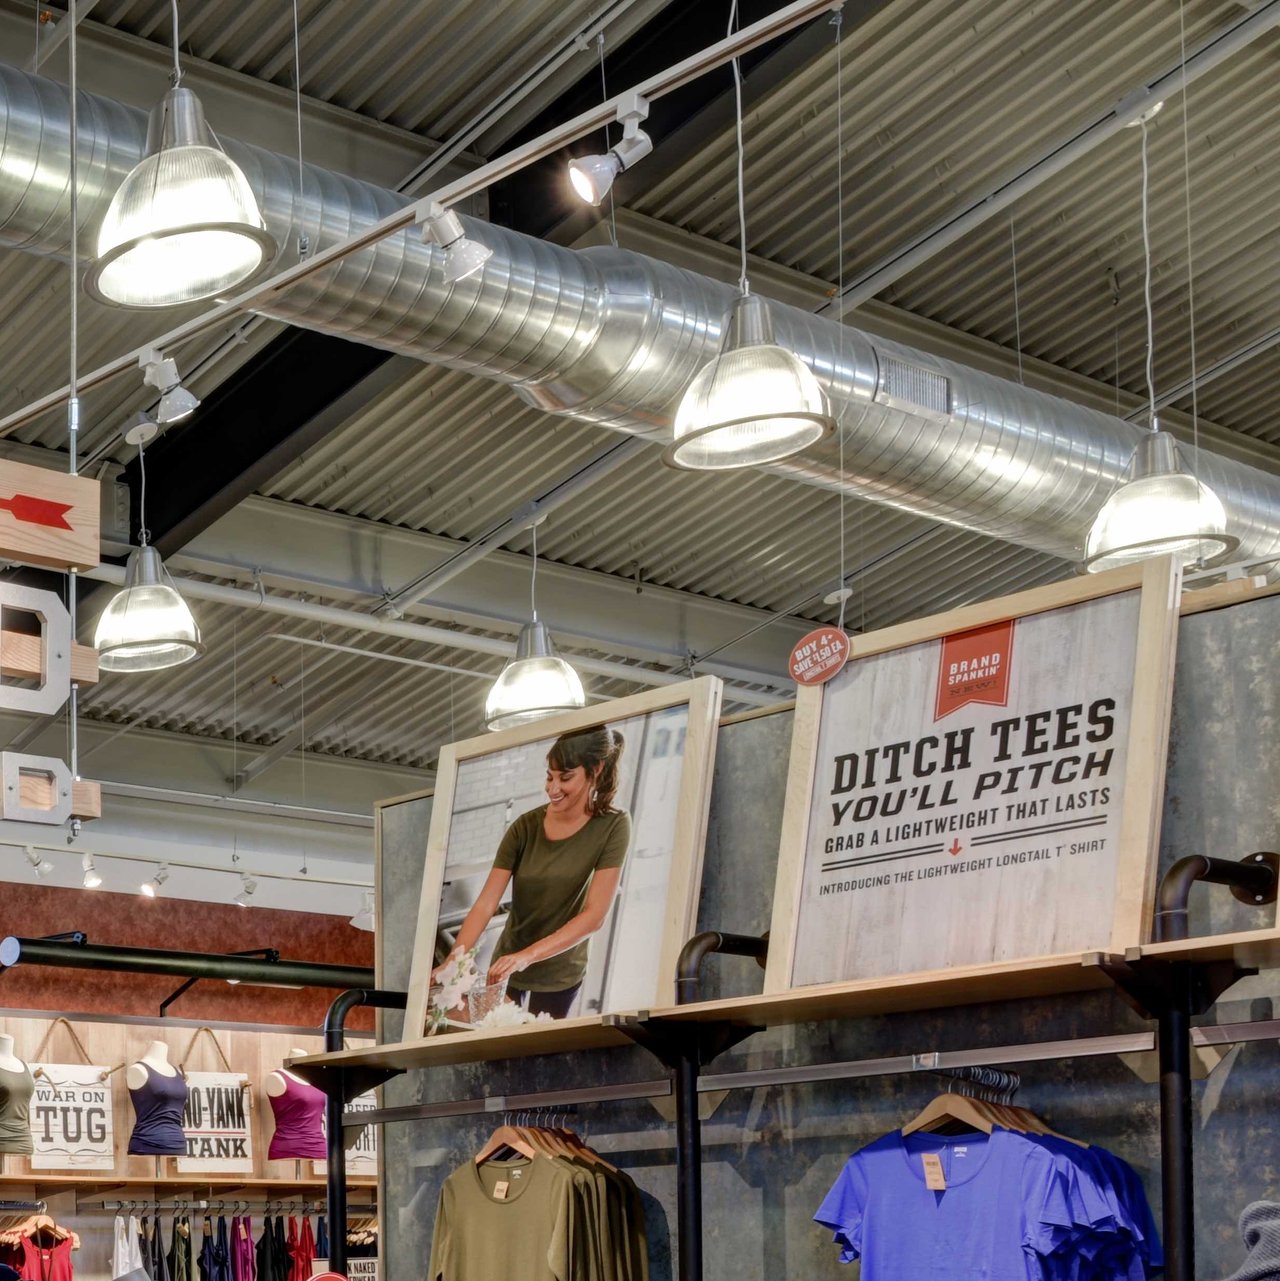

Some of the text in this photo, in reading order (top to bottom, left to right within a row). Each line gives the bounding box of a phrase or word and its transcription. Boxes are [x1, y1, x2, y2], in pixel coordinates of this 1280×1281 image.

[795, 640, 817, 661] BUY
[793, 656, 814, 676] SAVE
[950, 653, 1001, 675] BRAND
[948, 665, 1001, 685] SPANKIN'
[830, 698, 1116, 796] DITCH TEES
[831, 748, 1115, 827] YOU'LL PITCH
[824, 787, 1110, 854] GRAB A LIGHTWEIGHT THAT LASTS
[819, 874, 891, 896] INTRODUCING
[894, 870, 914, 884] THE
[917, 858, 992, 880] LIGHTWEIGHT
[996, 849, 1051, 868] LONGTAIL
[1070, 839, 1107, 855] SHIRT
[36, 1090, 105, 1103] WAR ON
[36, 1106, 106, 1143] TUG
[186, 1138, 248, 1158] TANK
[354, 1262, 376, 1274] NAKED
